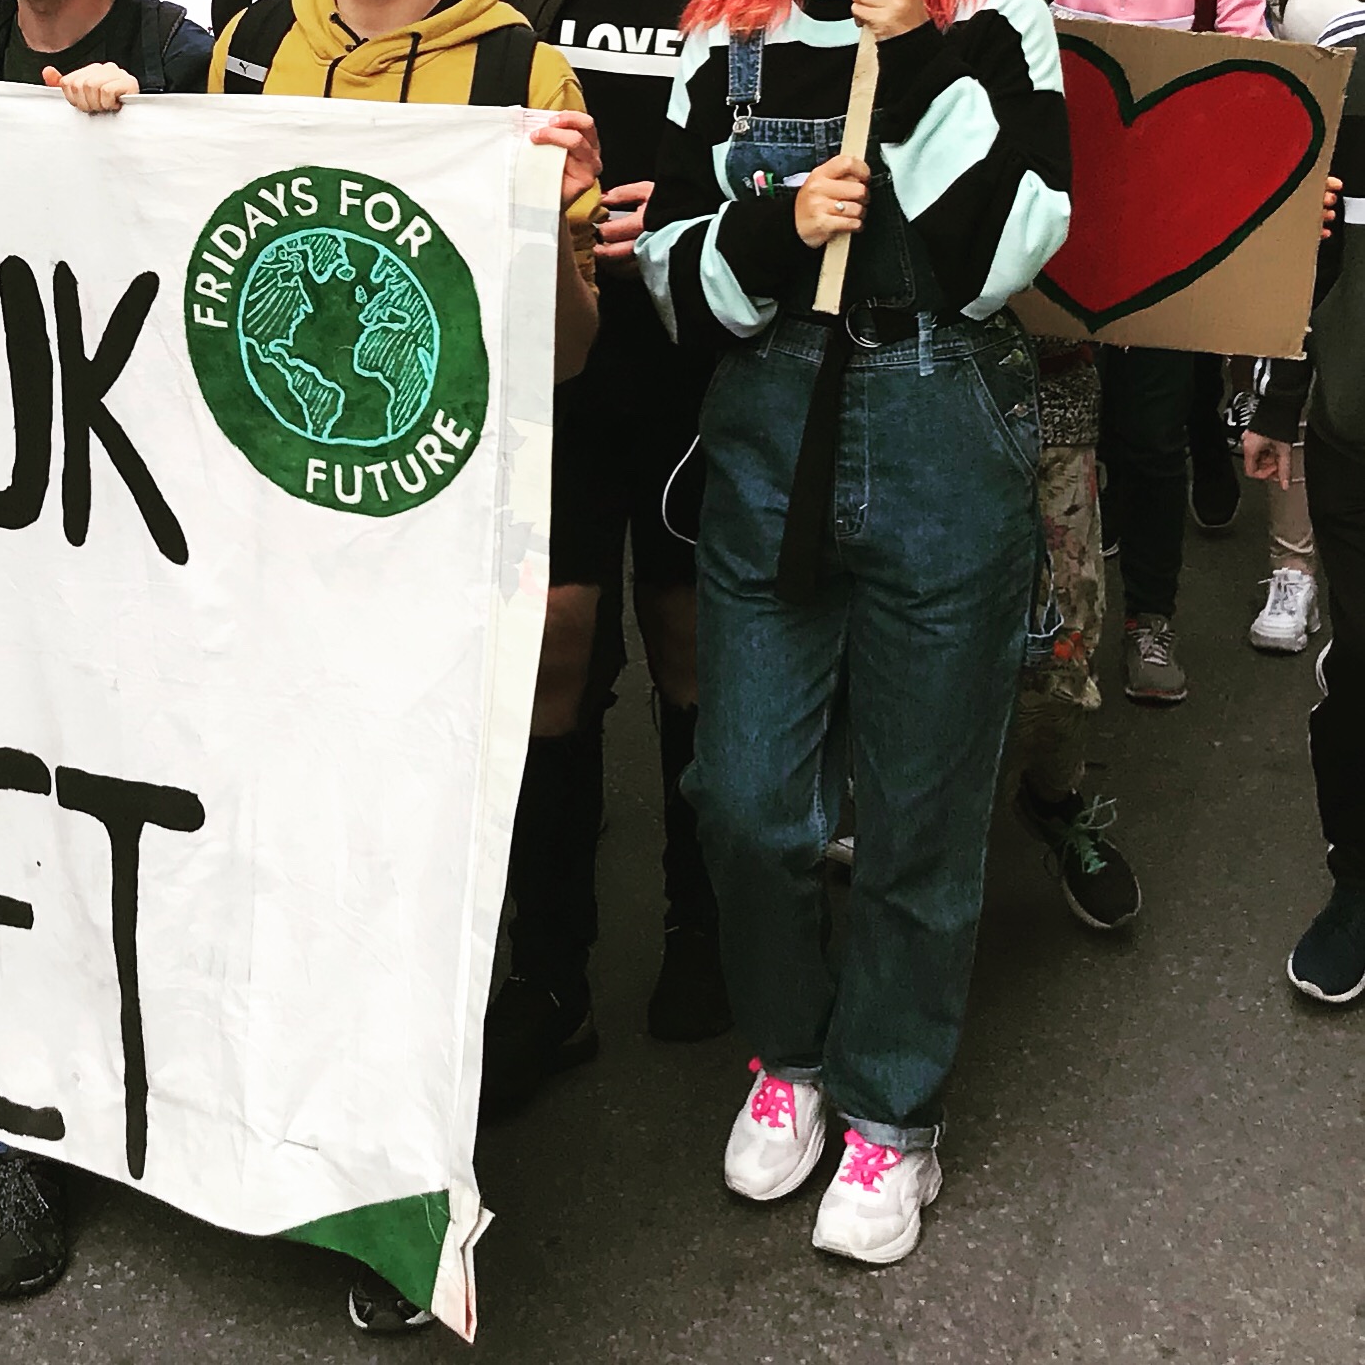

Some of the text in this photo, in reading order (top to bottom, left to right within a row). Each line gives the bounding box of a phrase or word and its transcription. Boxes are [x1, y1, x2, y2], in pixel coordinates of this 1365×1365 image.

[193, 176, 433, 328] FRIDAYS FOR
[305, 408, 473, 505] FUTURE
